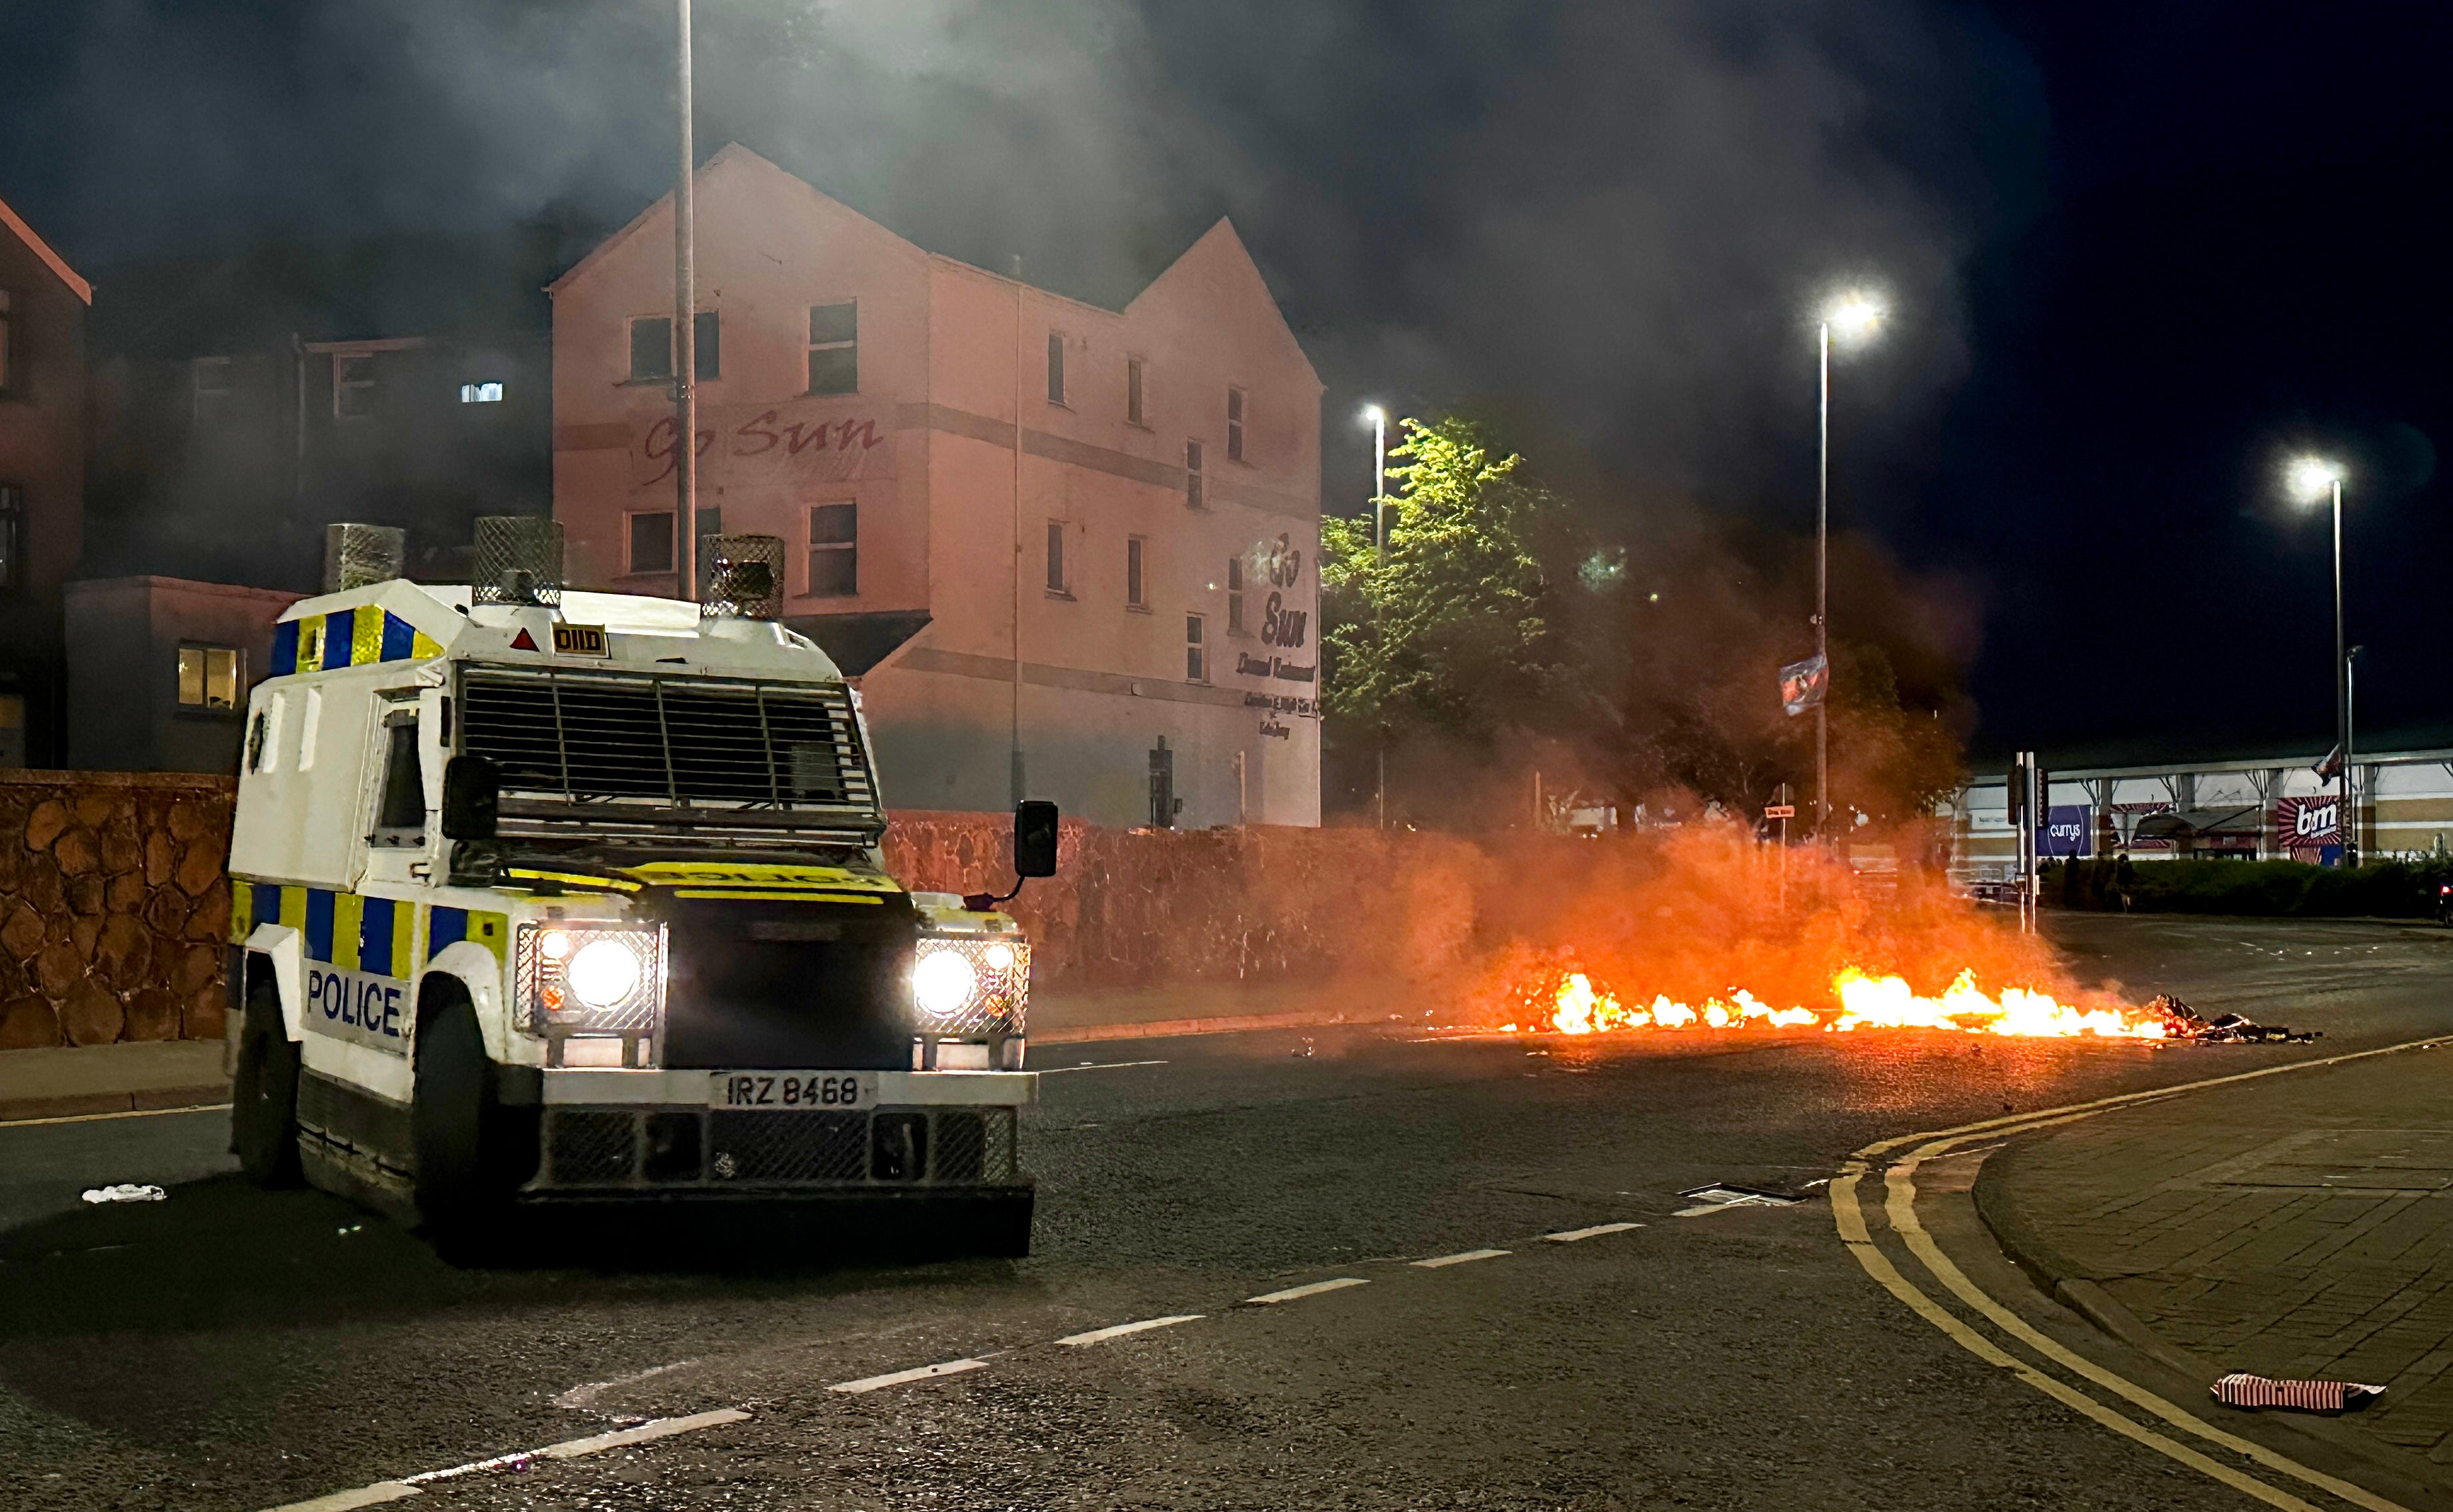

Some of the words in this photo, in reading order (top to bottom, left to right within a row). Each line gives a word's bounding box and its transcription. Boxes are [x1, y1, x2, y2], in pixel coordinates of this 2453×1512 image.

[734, 410, 883, 456] Sun
[1261, 591, 1307, 648] Sun
[307, 970, 401, 1037] POLICE
[727, 1077, 774, 1105] IRZ
[783, 1077, 857, 1105] 8468
